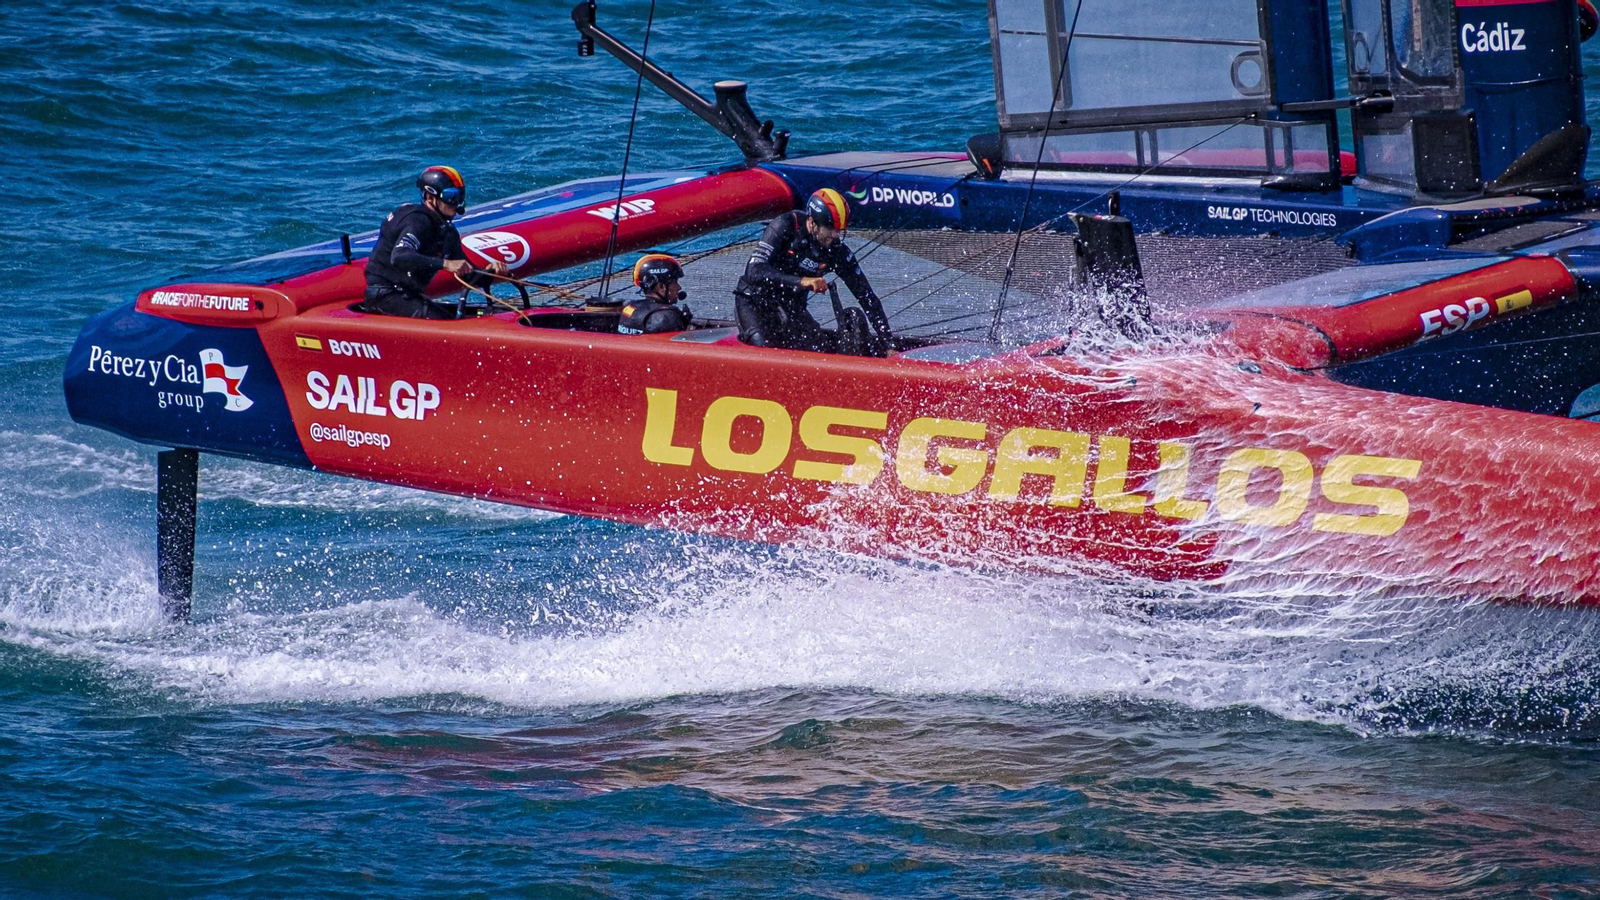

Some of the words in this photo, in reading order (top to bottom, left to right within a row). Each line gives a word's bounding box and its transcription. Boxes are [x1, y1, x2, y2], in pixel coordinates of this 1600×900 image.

[1461, 22, 1526, 52] Cádiz
[872, 187, 894, 202] DP
[895, 188, 955, 208] WORLD
[586, 199, 655, 220] WIP
[1249, 208, 1337, 227] TECHNOLOGIES
[151, 291, 250, 311] #RACEFORTHEFUTURE
[1418, 297, 1490, 340] ESP
[328, 338, 381, 359] BOTIN
[148, 360, 162, 387] y
[157, 391, 204, 413] group
[310, 422, 391, 450] @sailgpesp
